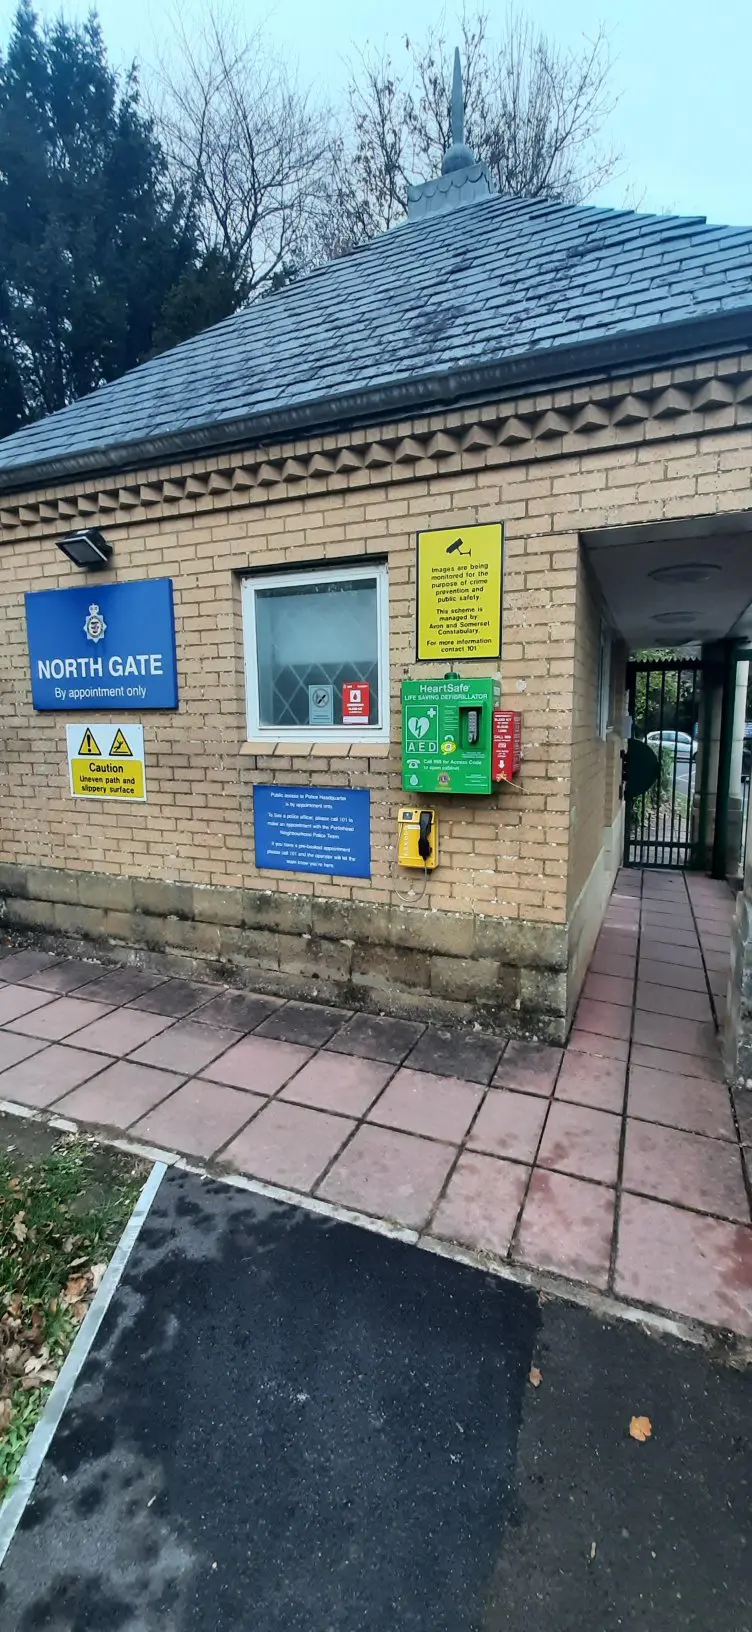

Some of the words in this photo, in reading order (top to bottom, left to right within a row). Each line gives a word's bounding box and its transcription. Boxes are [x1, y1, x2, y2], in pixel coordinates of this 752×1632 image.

[436, 588, 469, 596] prevention
[38, 658, 103, 679] NORTH
[108, 654, 163, 676] GATE
[54, 687, 66, 700] By
[68, 686, 124, 700] appointment
[126, 684, 146, 699] only
[89, 763, 124, 773] Caution
[79, 776, 103, 784] Uneven
[105, 776, 120, 785] path
[122, 776, 135, 785] and
[82, 784, 106, 793] slippery
[109, 786, 134, 794] surface
